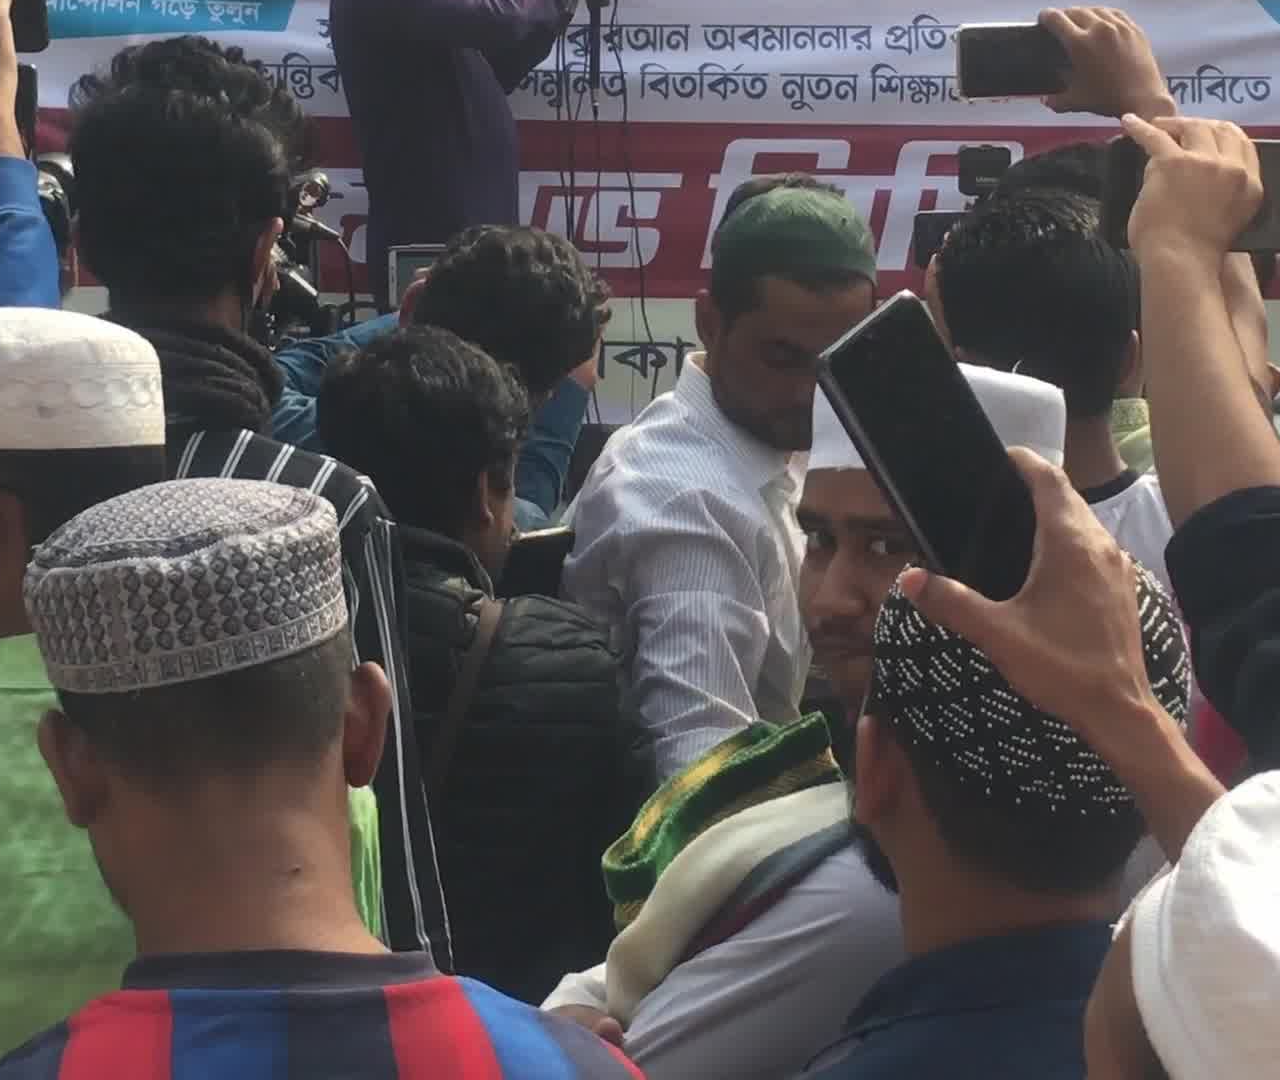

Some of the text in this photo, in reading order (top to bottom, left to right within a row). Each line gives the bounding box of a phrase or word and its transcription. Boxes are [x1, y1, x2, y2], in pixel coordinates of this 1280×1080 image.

[701, 24, 872, 53] অবমাননার
[640, 62, 769, 102] বিতর্কিত
[1167, 64, 1272, 104] দাবিতে
